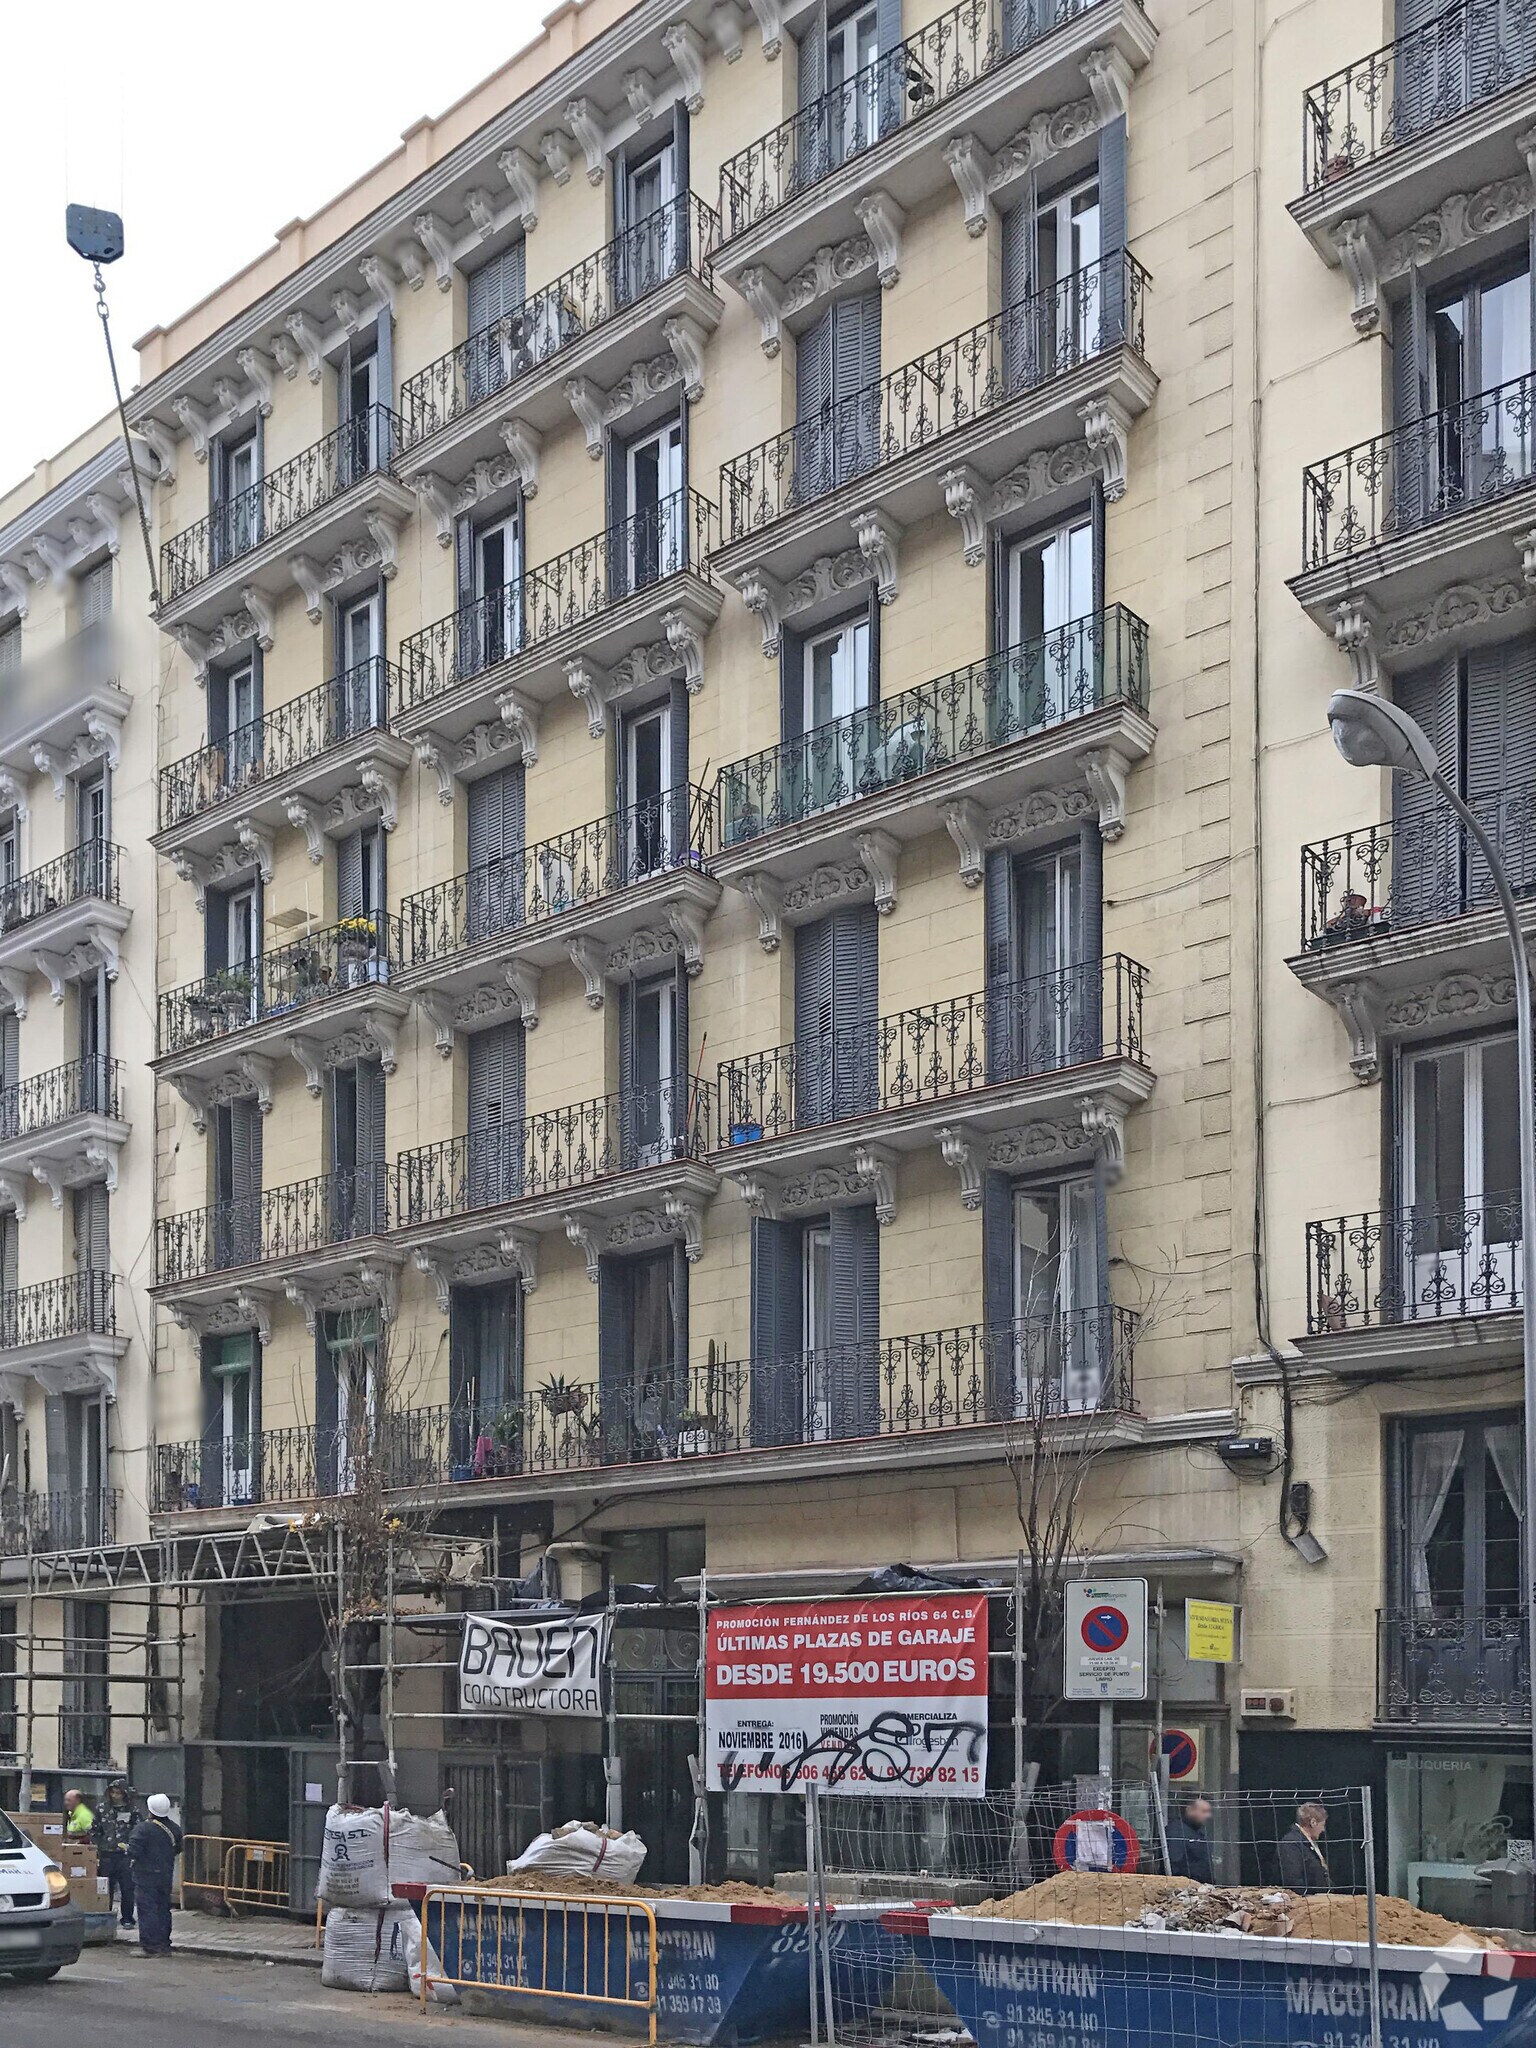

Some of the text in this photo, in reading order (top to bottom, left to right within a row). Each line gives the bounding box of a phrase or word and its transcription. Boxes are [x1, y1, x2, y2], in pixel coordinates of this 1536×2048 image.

[716, 1609, 976, 1629] PROMOCIÓN FERNÁNDEZ DE LOS RÍOS 64 C.B.
[717, 1627, 976, 1652] ÚLTIMAS PLAZAS DE GARAJE
[463, 1623, 598, 1679] BAUEN
[716, 1658, 976, 1686] DESDE 19.500 EUROS
[464, 1683, 598, 1711] CONSTRUCTORA
[737, 1720, 774, 1728] ENTREGA:
[820, 1711, 859, 1725] PROMOCIÓN
[902, 1712, 958, 1721] OMERCIALIZA
[718, 1731, 801, 1749] NOVIEMBRE 2016
[938, 1767, 957, 1782] 82
[962, 1767, 979, 1782] 15
[628, 1931, 716, 1961] MAOTRAN
[689, 1974, 702, 1990] 31
[705, 1974, 719, 1991] 80
[978, 1952, 1099, 2000] MACOTRAN
[669, 1995, 690, 2013] 359
[1286, 1977, 1440, 2022] MACORAN
[1006, 2003, 1023, 2023] 91
[1027, 2006, 1053, 2026] 345
[1058, 2010, 1075, 2030] 31
